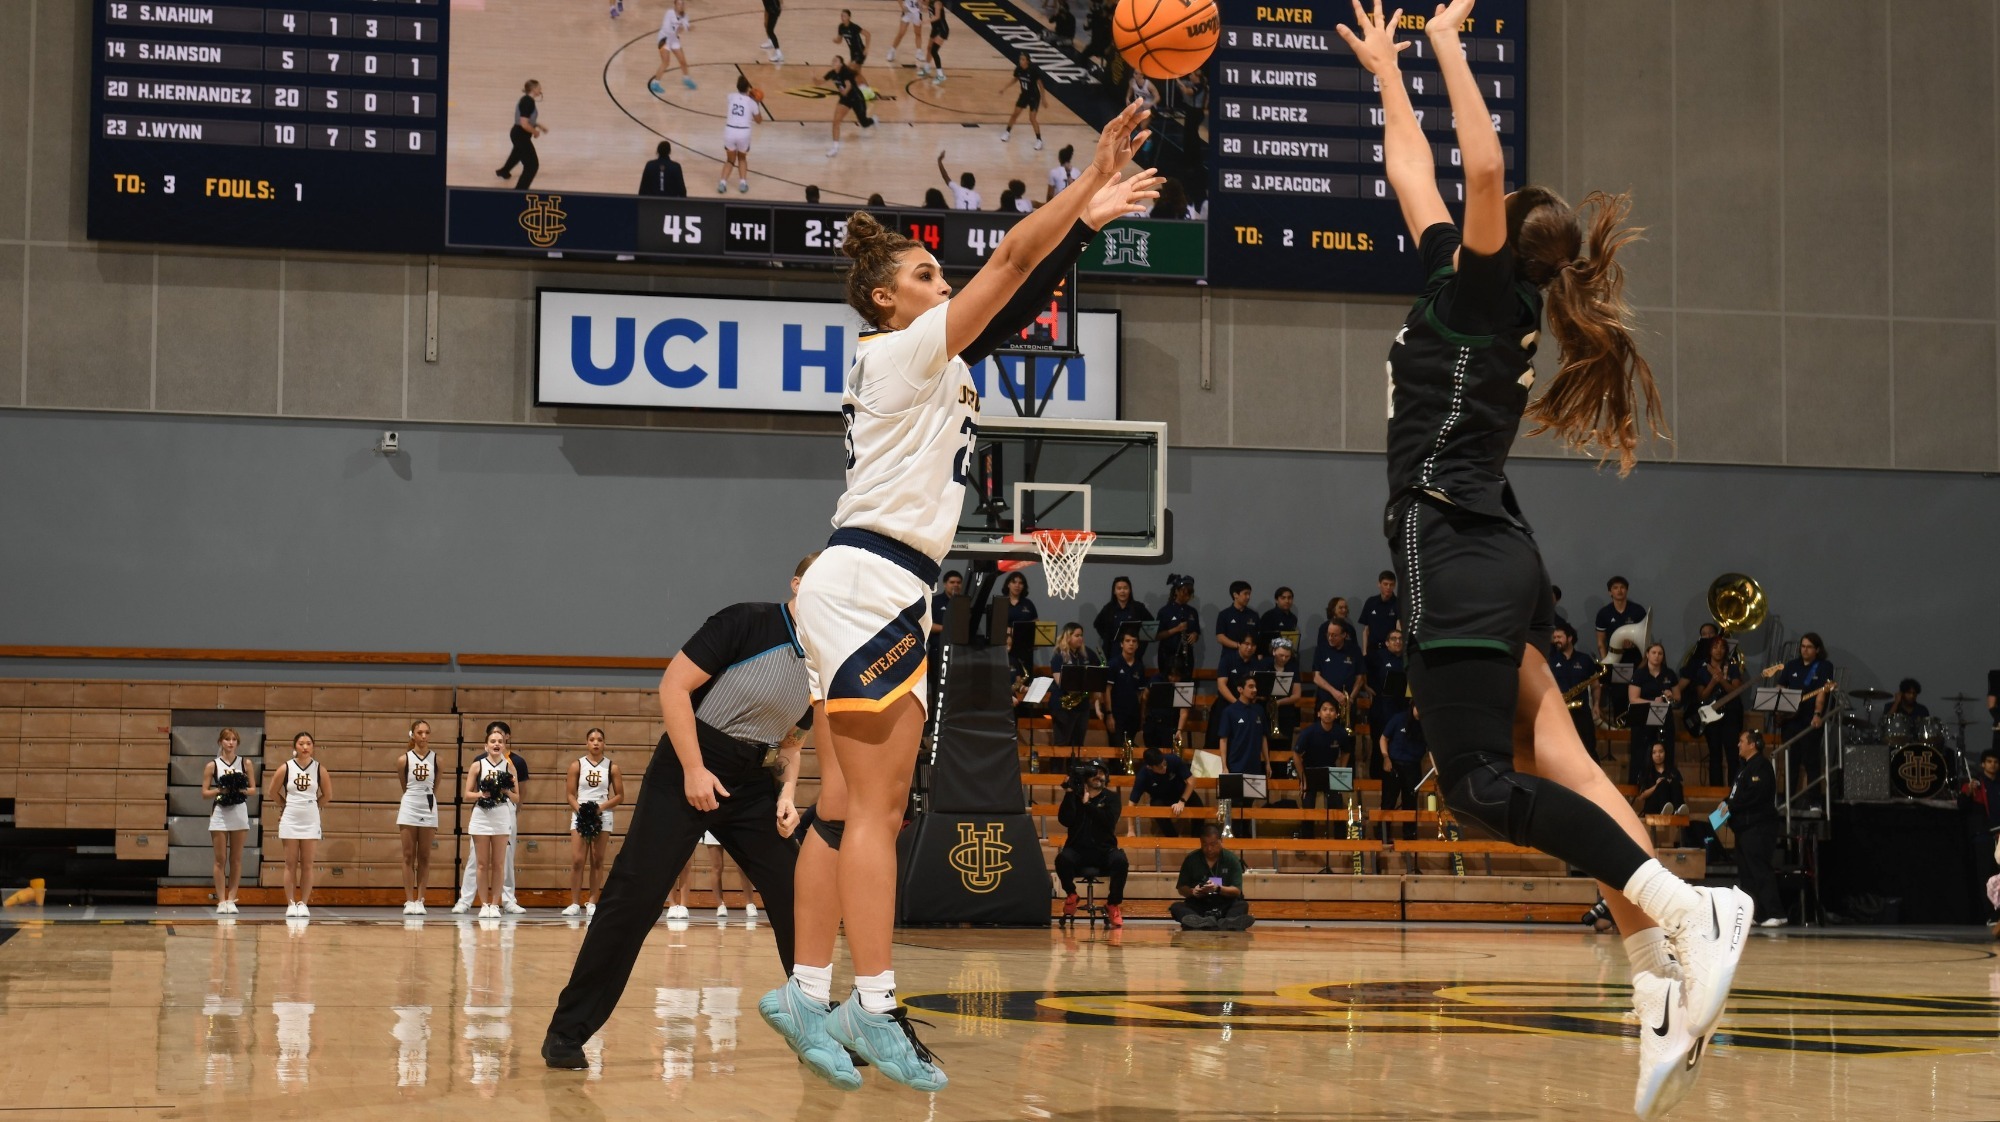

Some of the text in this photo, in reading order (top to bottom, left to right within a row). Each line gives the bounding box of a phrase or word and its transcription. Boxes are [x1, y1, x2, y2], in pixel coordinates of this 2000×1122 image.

[111, 4, 421, 40] 12 S.NAHUM 4 1 3 1
[1257, 7, 1312, 24] PLAYER
[1496, 20, 1504, 33] F
[108, 42, 419, 76] 14 S.HANSON 5 7 0 1
[1228, 31, 1504, 61] 3 B.FLAVELL 1 1
[1227, 69, 1238, 83] 11
[1251, 71, 1317, 87] K.CURTIS
[1413, 77, 1424, 94] 4
[1494, 81, 1501, 98] 1
[108, 82, 419, 114] 20 H.HERNANDEZ 20 5 0 1
[731, 103, 745, 117] 23
[1226, 103, 1240, 118] 12
[1253, 106, 1307, 123] I.PEREZ
[1370, 108, 1385, 125] 10
[1491, 113, 1501, 131] 2
[107, 120, 420, 150] 23 J.WYNN 10 7 5 0
[1223, 139, 1461, 166] 20 I.FORSYTH 3 0
[114, 174, 175, 194] TO: 3
[206, 178, 302, 201] FOULS: 1
[1224, 174, 1462, 200] 22 J.PEACOCK 0 1
[663, 215, 702, 244] 45
[730, 222, 767, 241] 4TH
[910, 223, 940, 249] 14
[1235, 227, 1293, 247] TO: 2
[1312, 231, 1404, 252] FOULS: 1
[571, 316, 739, 389] UCI
[1010, 343, 1053, 351] DAKTRONICS
[859, 632, 917, 687] ANTEATERS
[930, 645, 950, 766] UCI Health
